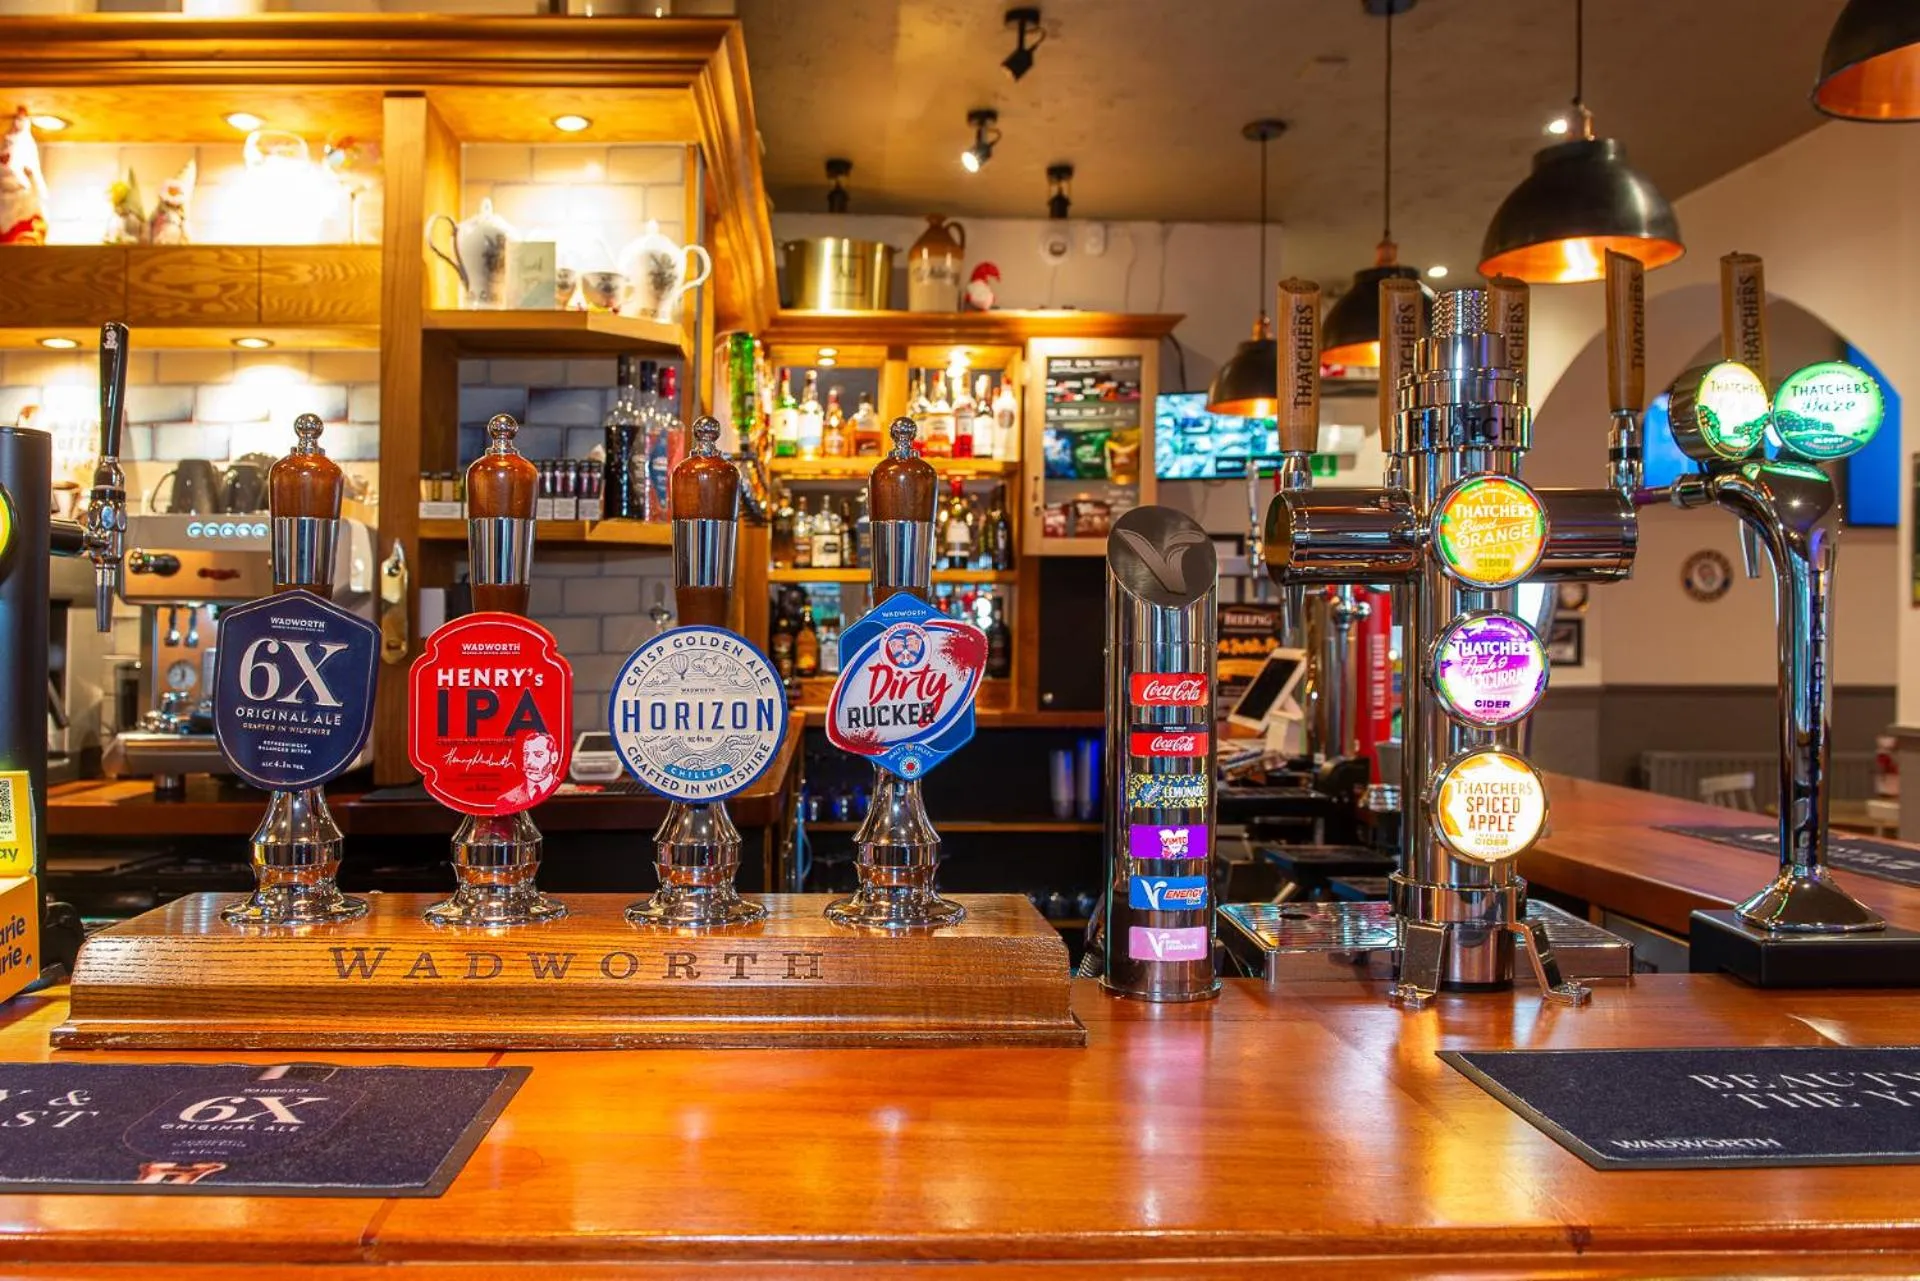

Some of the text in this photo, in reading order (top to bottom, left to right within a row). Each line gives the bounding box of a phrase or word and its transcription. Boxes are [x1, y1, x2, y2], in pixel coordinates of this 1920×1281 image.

[1294, 304, 1315, 410] THATCHERS
[1790, 382, 1870, 397] THATCHERS
[1455, 503, 1534, 518] THATCHERS
[1456, 523, 1531, 549] ORANGE
[270, 616, 326, 629] WADWORTH
[881, 609, 927, 618] WADWORTH
[461, 642, 521, 651] WADWORTH
[626, 635, 771, 687] CRISP GOLDEN ALE
[239, 638, 349, 707] 6X
[437, 667, 544, 687] HENRY's
[868, 662, 953, 728] Dirty
[1474, 699, 1511, 709] CIDER
[235, 707, 343, 726] ORIGINAL ALE
[437, 687, 549, 737] IPA
[622, 698, 774, 733] HORIZON
[847, 702, 936, 729] RUCKER
[627, 742, 771, 795] CRAFTED IN WILTSHIRE
[670, 766, 724, 779] CHILLED
[1455, 780, 1534, 796] THATCHERS
[1466, 796, 1521, 813] SPICED
[1468, 815, 1517, 832] APPLE
[328, 946, 825, 981] WADWORTH
[1721, 1092, 1862, 1109] THE
[179, 1096, 330, 1124] 6X
[160, 1123, 301, 1133] ORIGINAL ALE
[1609, 1138, 1784, 1149] WADWORTH
